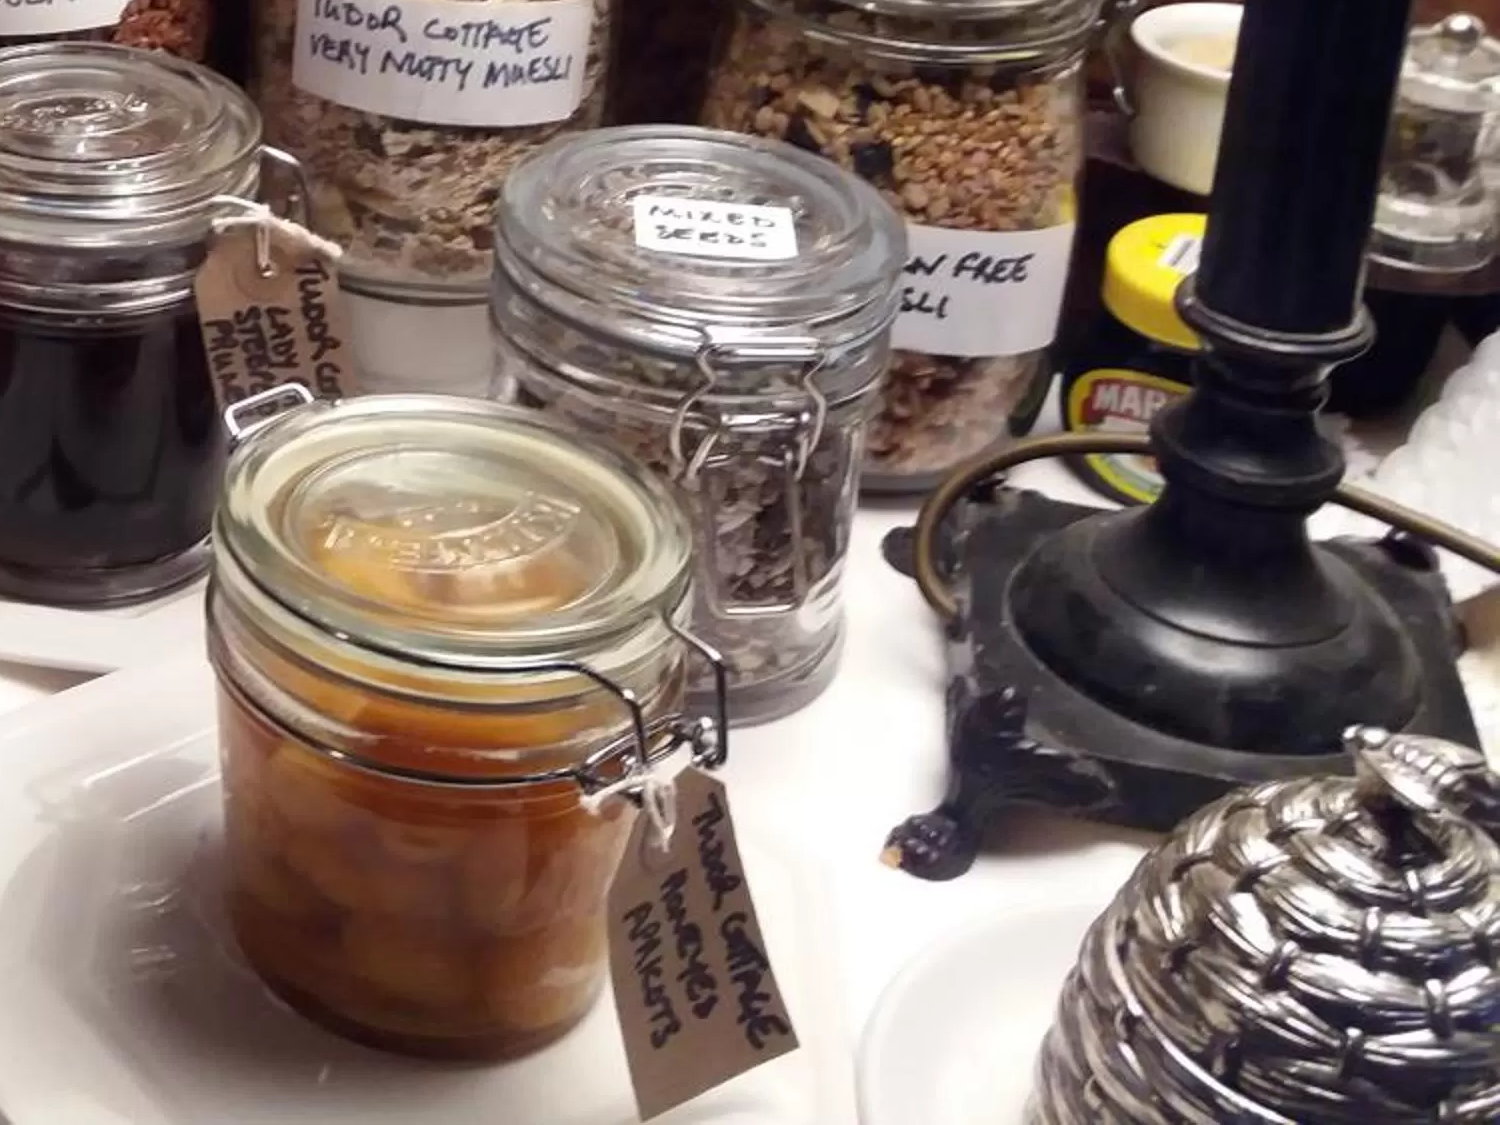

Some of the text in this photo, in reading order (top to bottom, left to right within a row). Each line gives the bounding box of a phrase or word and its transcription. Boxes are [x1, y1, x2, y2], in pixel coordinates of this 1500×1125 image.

[310, 32, 573, 92] VERY NUTTY MUESLI
[423, 16, 552, 53] COTTAGE
[265, 306, 300, 368] LADY
[294, 258, 342, 361] TUDOR
[692, 791, 790, 1051] TUDOR COTTAGE
